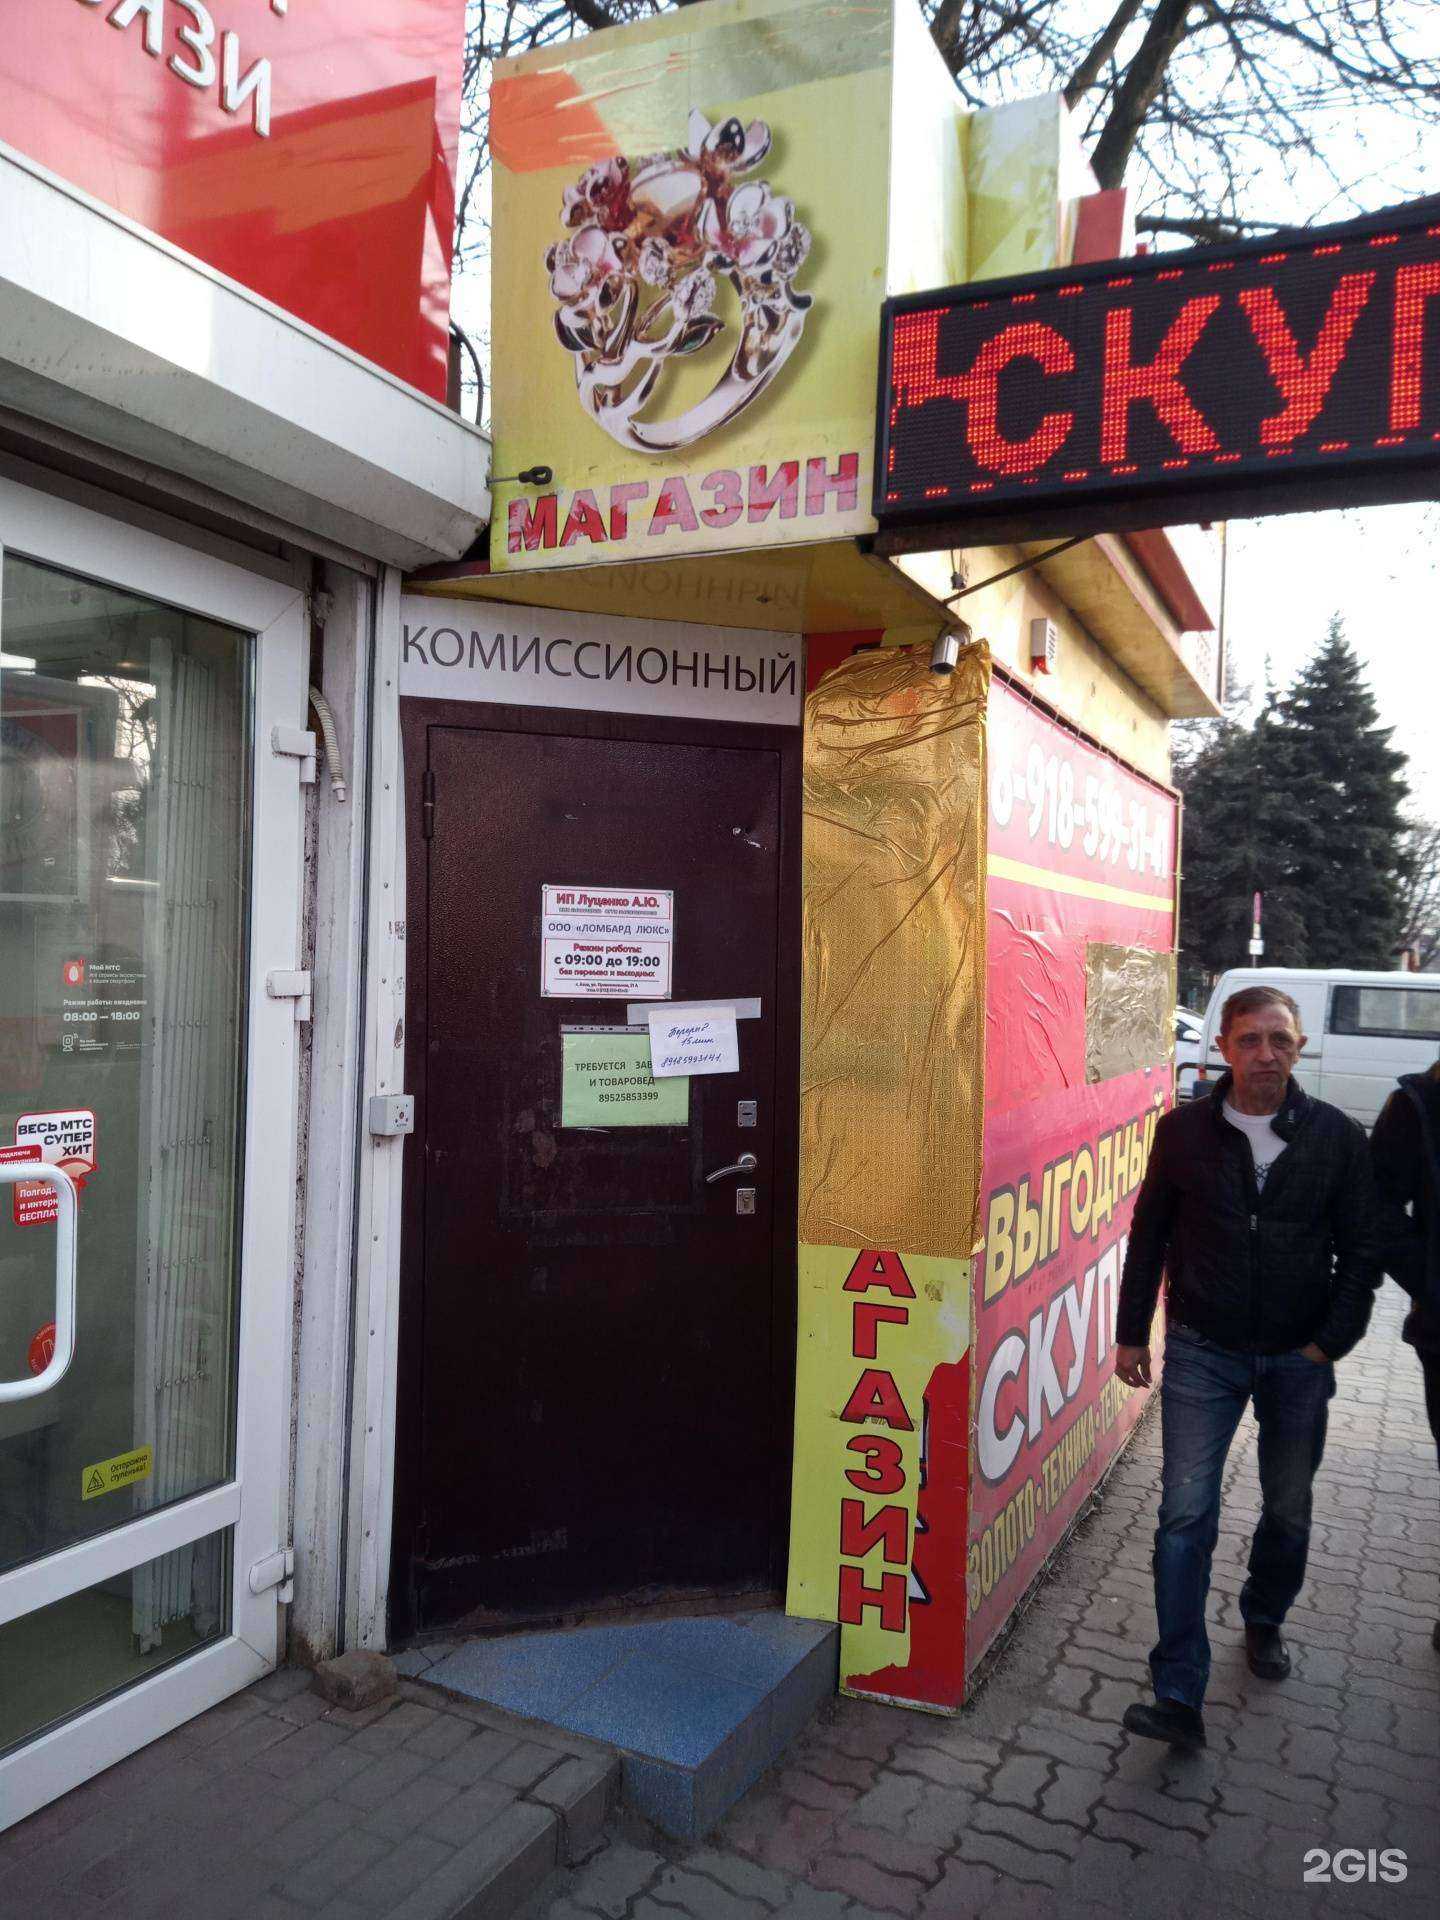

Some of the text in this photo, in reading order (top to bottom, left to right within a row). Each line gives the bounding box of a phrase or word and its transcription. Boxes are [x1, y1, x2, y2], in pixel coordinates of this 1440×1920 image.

[75, 0, 271, 138] ЯЗИ
[507, 452, 860, 554] МАГАЗИН
[402, 624, 796, 695] КОМИССИОННЫЙ
[556, 893, 661, 909] ИП Луценко А.Ю.
[548, 923, 670, 935] ООО «ЛОМБАРД ЛЮКС»
[554, 955, 661, 968] с 09:00 до 19:00
[63, 1012, 98, 1022] 08:00
[574, 1061, 626, 1072] ТРЕБУЕТСЯ
[589, 1076, 656, 1087] И ТОВАРОВЕД
[598, 1091, 659, 1103] 89525853399
[17, 1118, 93, 1136] ВЕСЬ МТС
[44, 1131, 92, 1146] СУПЕР
[62, 1143, 92, 1157] ХИТ
[978, 1235, 1129, 1480] СКУП
[968, 1476, 1036, 1613] ЗОЛОТО
[1041, 1403, 1096, 1515] ТЕХНИКА
